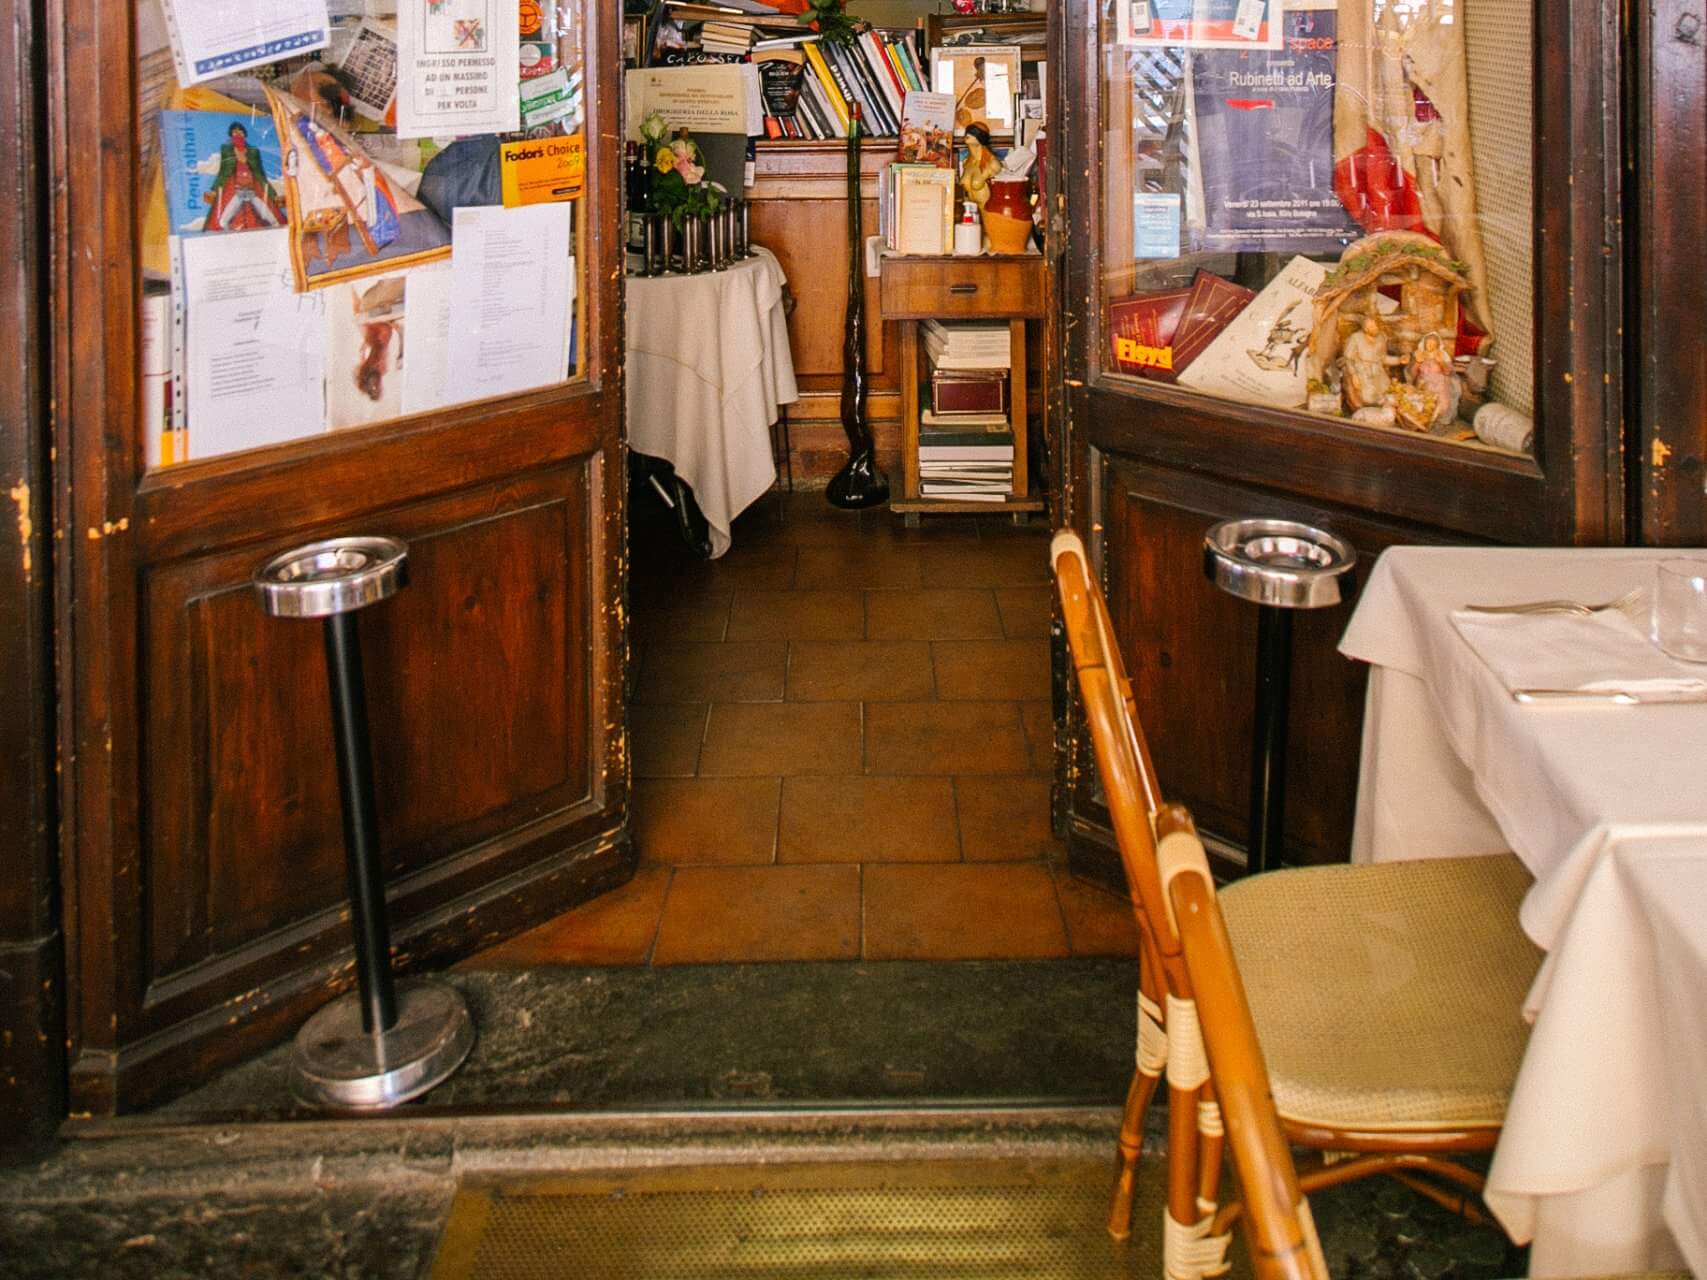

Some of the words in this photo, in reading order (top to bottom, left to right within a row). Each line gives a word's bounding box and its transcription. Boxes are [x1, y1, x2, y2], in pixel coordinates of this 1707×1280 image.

[425, 73, 437, 82] AD
[453, 71, 488, 81] MASSIMO
[1230, 71, 1284, 87] Rubinetti
[1287, 72, 1303, 86] ad
[1305, 71, 1332, 87] Arte
[455, 85, 488, 95] PERSONE
[437, 101, 451, 110] PER
[454, 100, 477, 109] VOLTA
[504, 146, 544, 163] Fodor's
[546, 142, 580, 157] Choice
[1118, 337, 1173, 369] Floyd
